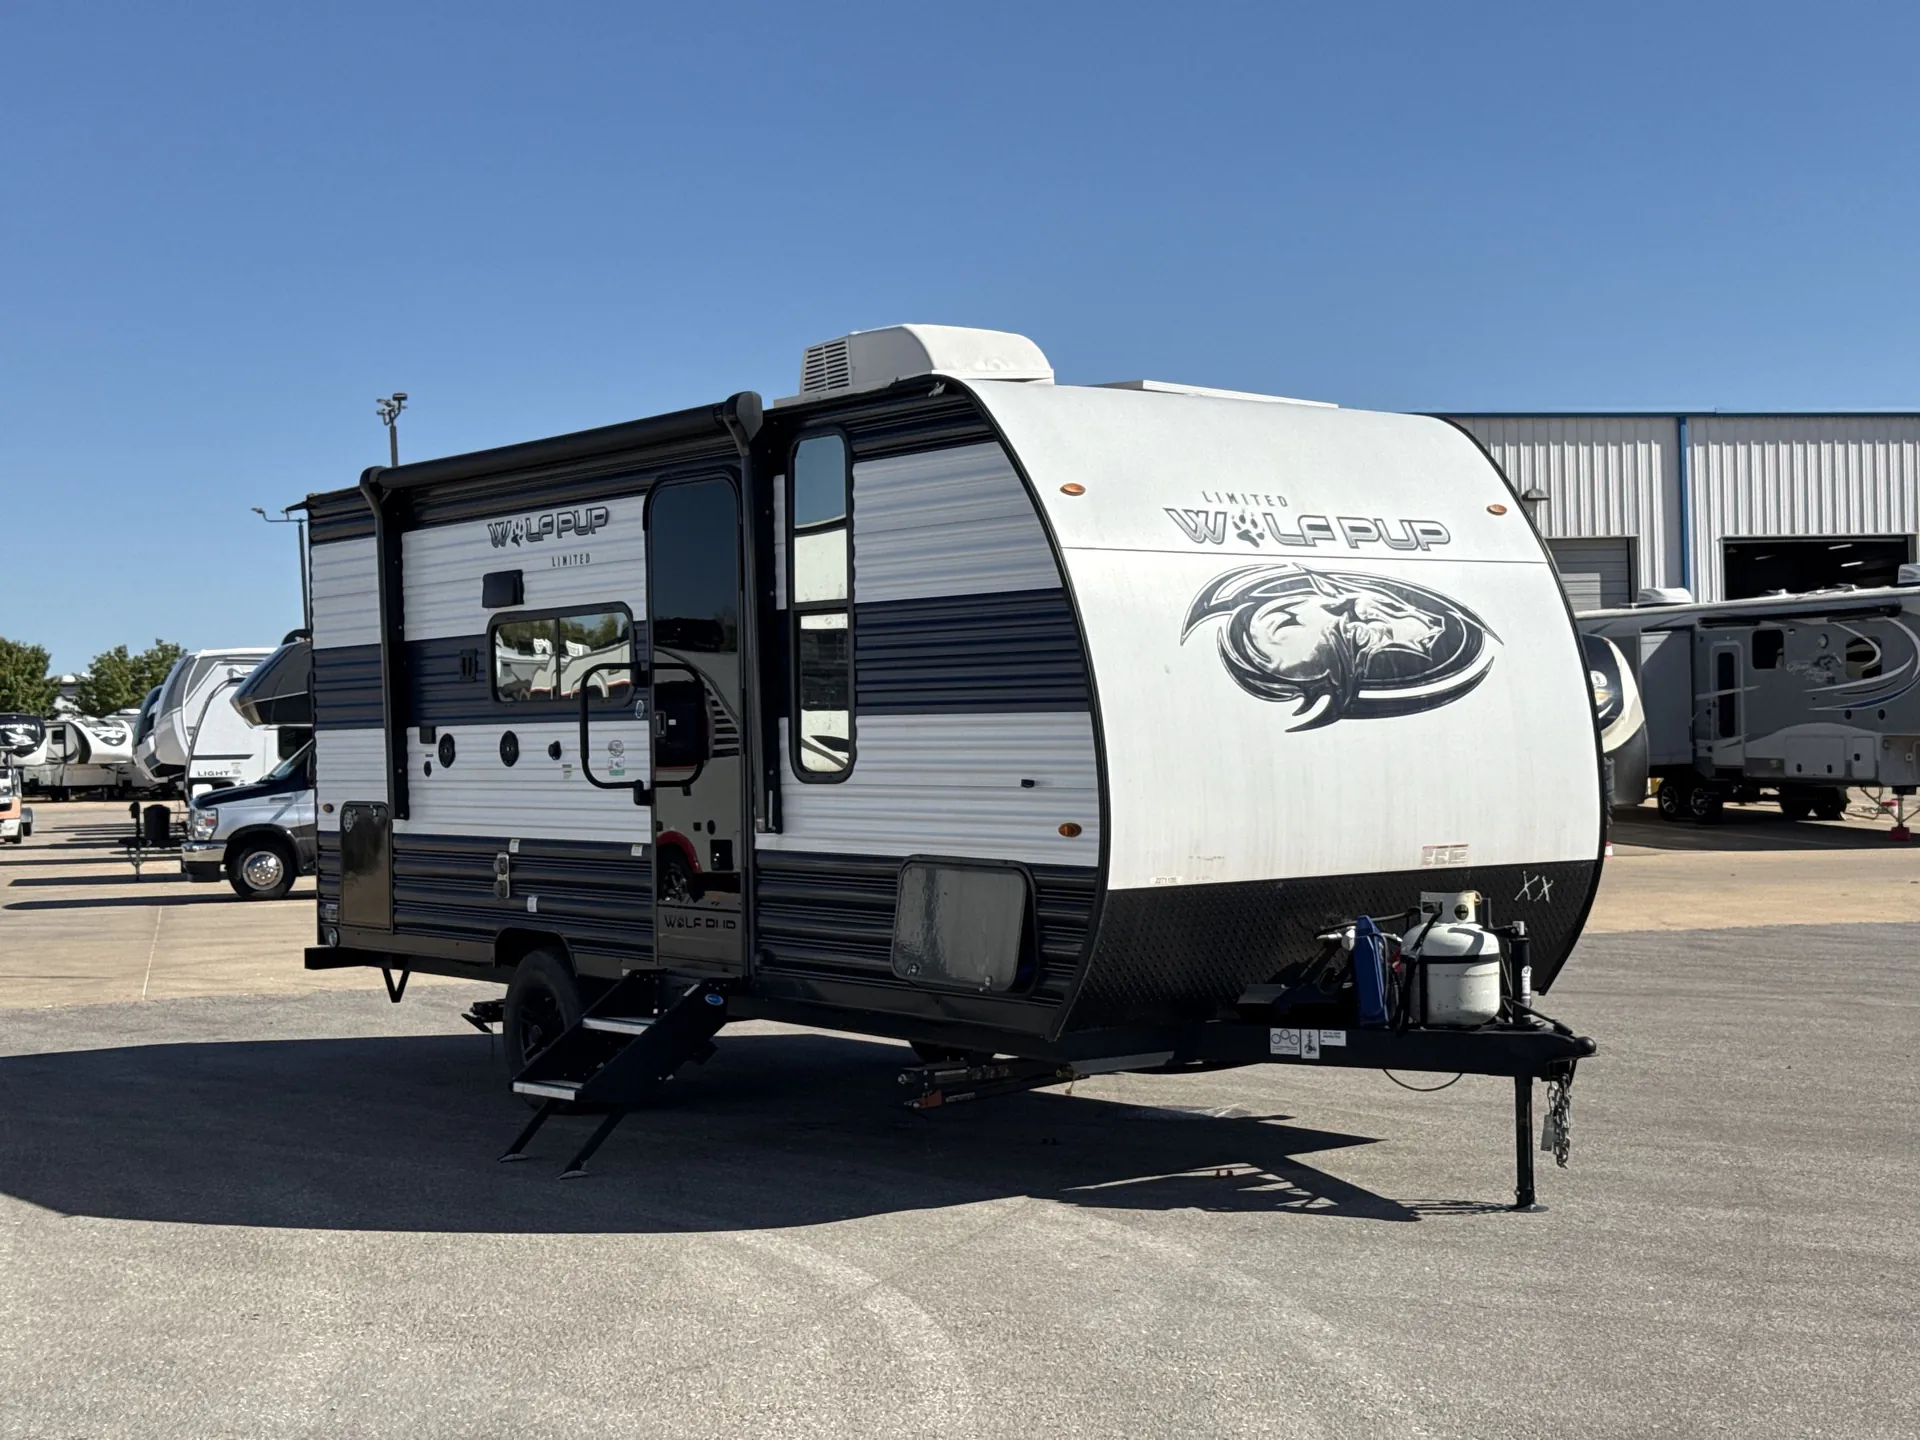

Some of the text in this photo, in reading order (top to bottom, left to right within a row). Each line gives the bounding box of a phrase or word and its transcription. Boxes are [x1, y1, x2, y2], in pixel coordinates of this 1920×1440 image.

[1202, 490, 1289, 508] LIMITED
[556, 506, 609, 538] PUP
[1336, 516, 1451, 552] PUP
[551, 553, 591, 567] LIMITED
